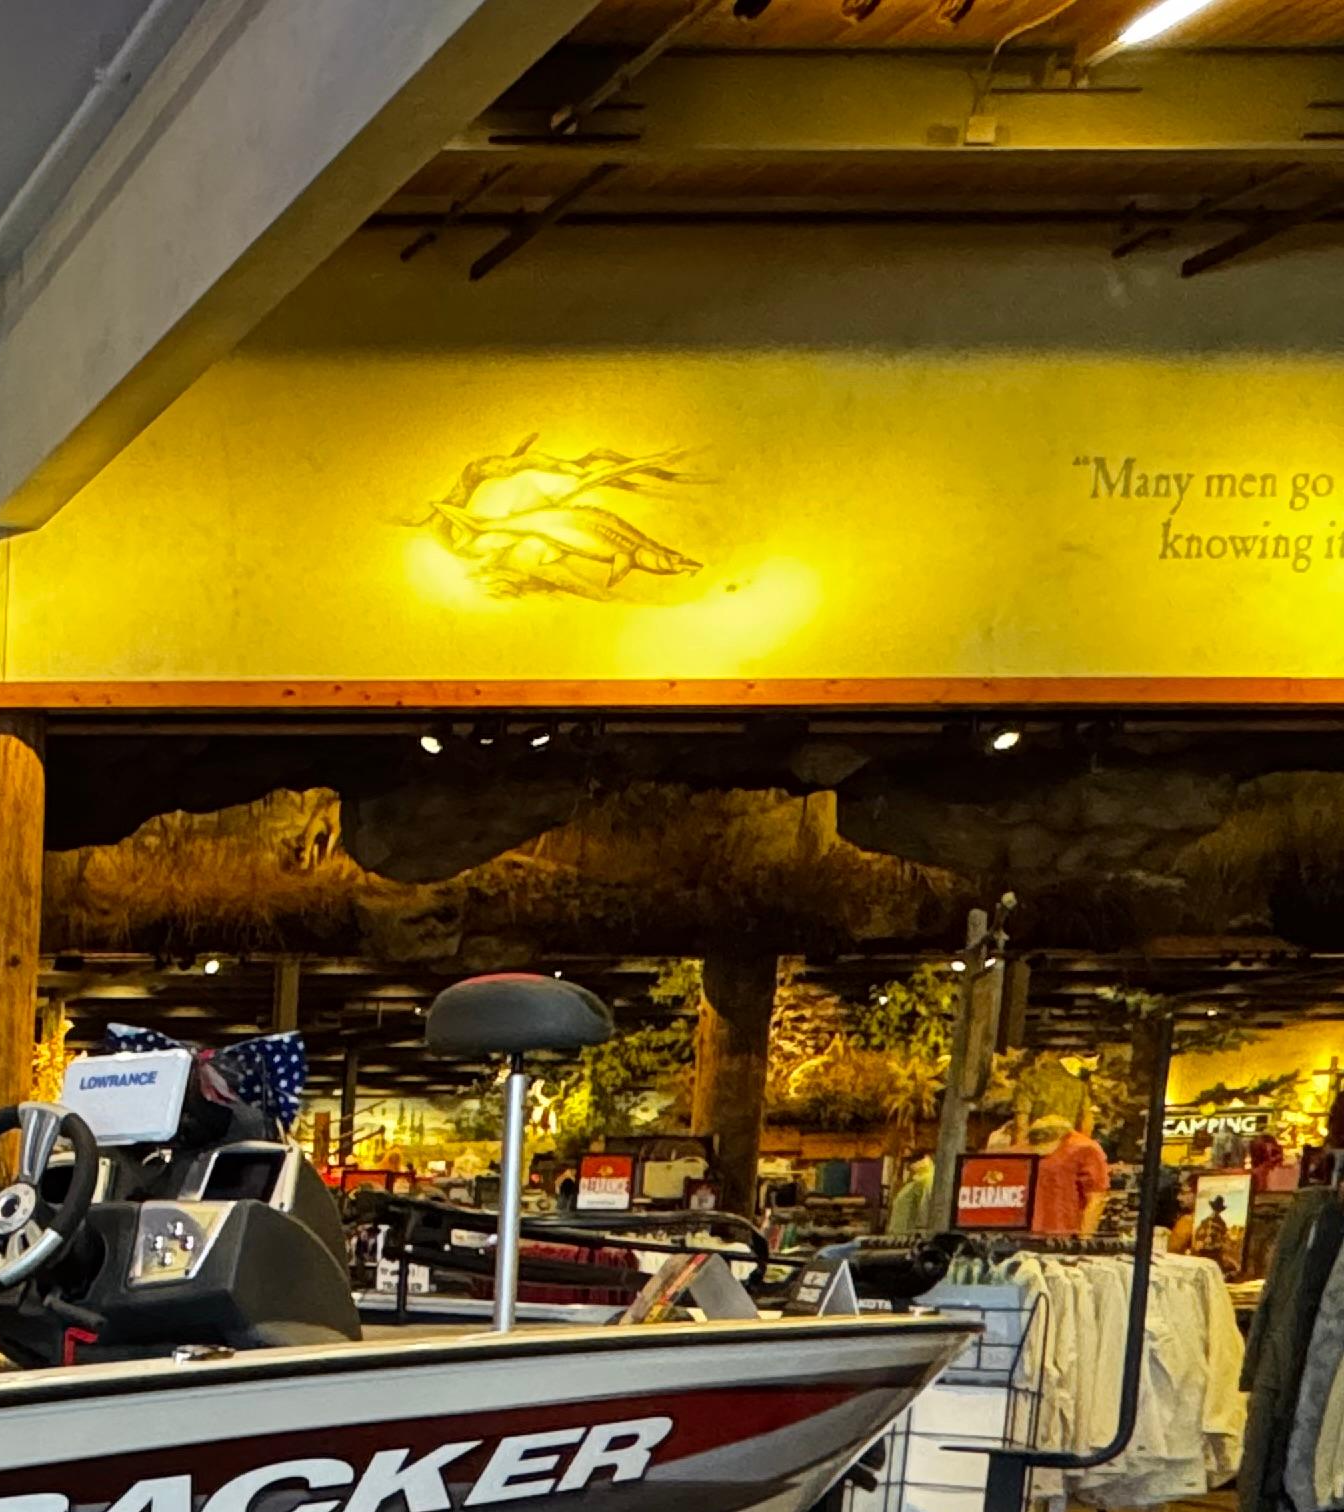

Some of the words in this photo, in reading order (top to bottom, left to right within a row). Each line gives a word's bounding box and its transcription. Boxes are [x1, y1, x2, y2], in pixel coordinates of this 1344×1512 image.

[1204, 472, 1278, 498] men
[1289, 472, 1335, 512] go
[1158, 517, 1313, 573] knowing
[79, 1070, 158, 1091] LOWRANCE
[1163, 1116, 1257, 1134] CAMPING
